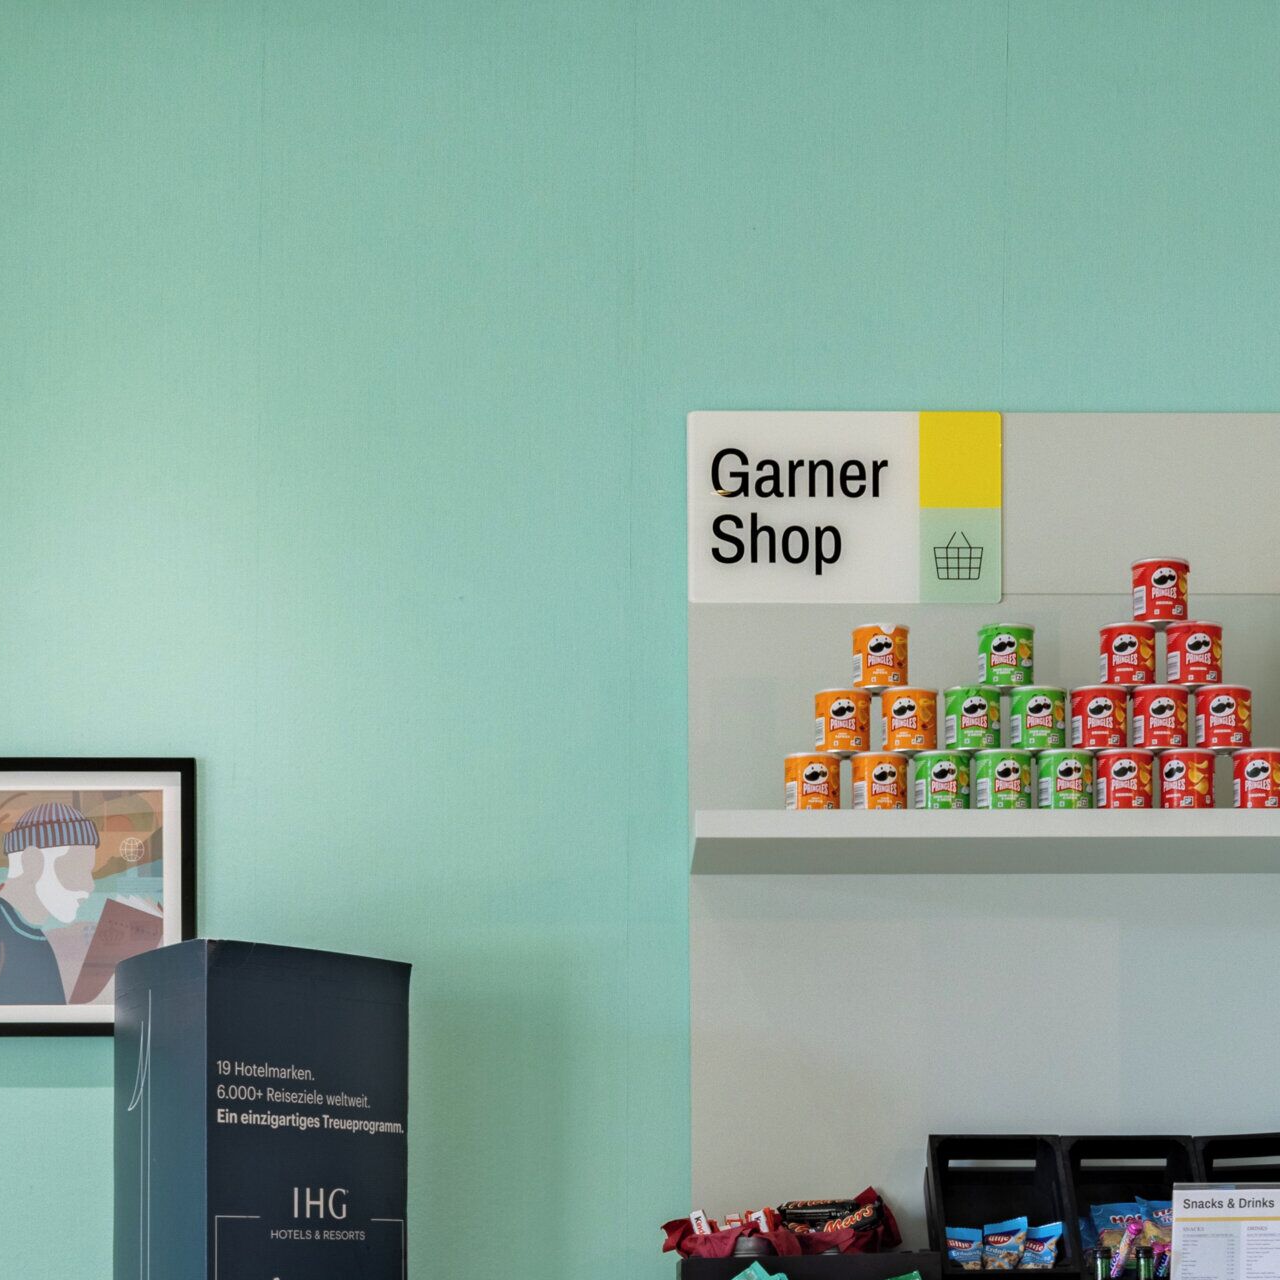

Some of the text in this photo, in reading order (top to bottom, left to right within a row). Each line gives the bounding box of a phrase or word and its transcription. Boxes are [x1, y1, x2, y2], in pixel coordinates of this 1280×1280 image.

[711, 447, 889, 498] Garner
[711, 512, 842, 576] Shop
[216, 1060, 315, 1081] 19 Hotelmarken.
[217, 1084, 371, 1109] 6.000+ Reiseziele weltweit.
[217, 1108, 405, 1135] Ein einzigartiges Treueprogramm.
[293, 1186, 348, 1219] IHG
[1183, 1197, 1275, 1210] Snacks & Drinks
[270, 1229, 366, 1241] HOTELS & RESORTS
